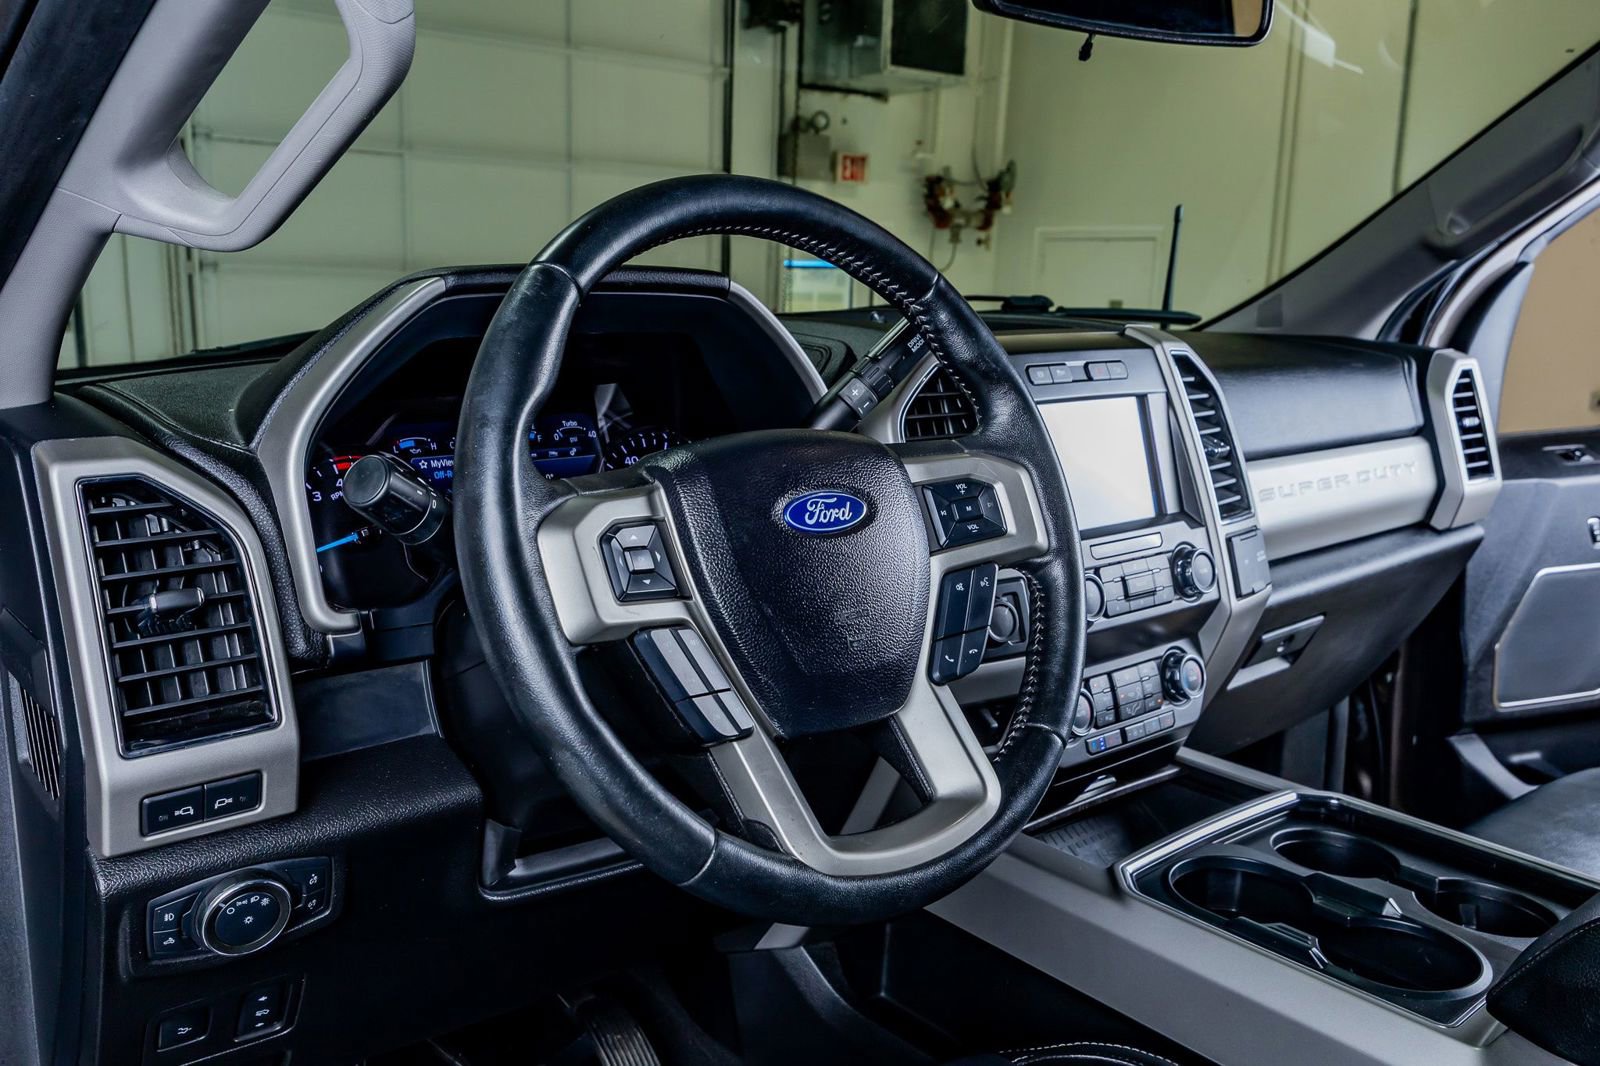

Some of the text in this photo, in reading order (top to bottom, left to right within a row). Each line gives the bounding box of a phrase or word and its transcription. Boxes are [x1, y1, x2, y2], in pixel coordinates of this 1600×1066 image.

[843, 155, 865, 181] EXIT
[587, 430, 597, 438] 40
[430, 442, 437, 451] H
[624, 455, 639, 466] 40
[1258, 461, 1415, 503] SUPER DUTY
[312, 491, 322, 502] 3
[804, 497, 853, 526] Ford
[966, 523, 980, 531] VOL
